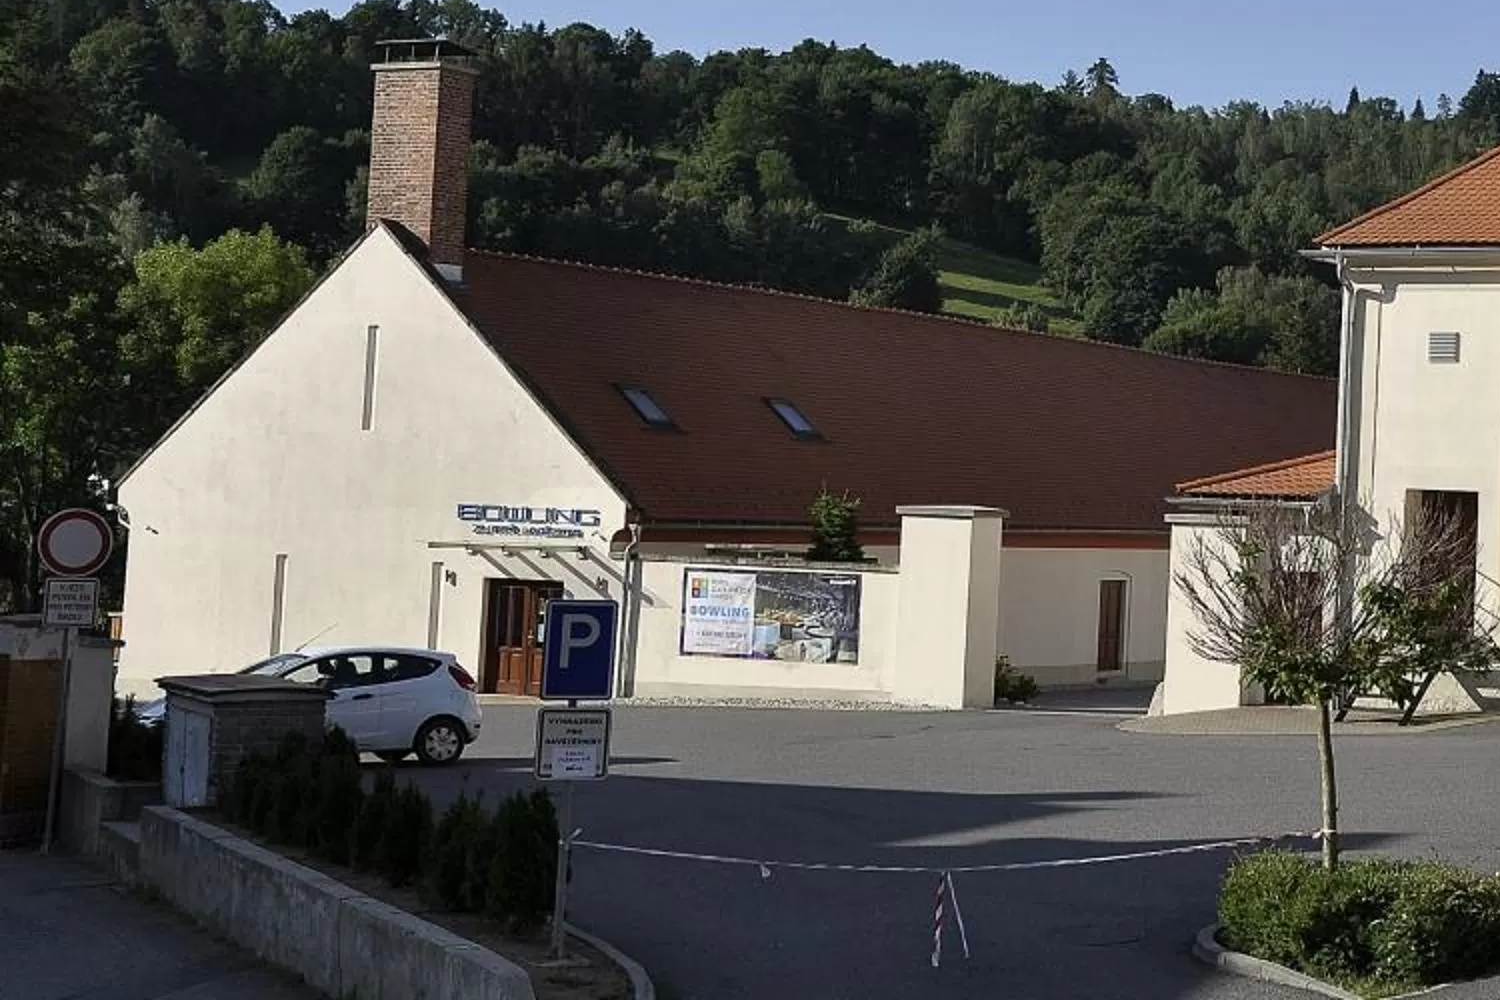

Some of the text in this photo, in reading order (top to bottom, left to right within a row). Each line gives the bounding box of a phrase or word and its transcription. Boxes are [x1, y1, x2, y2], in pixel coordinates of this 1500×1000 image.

[457, 503, 601, 527] BOWLING
[690, 604, 750, 617] BOWLING
[559, 613, 600, 668] P
